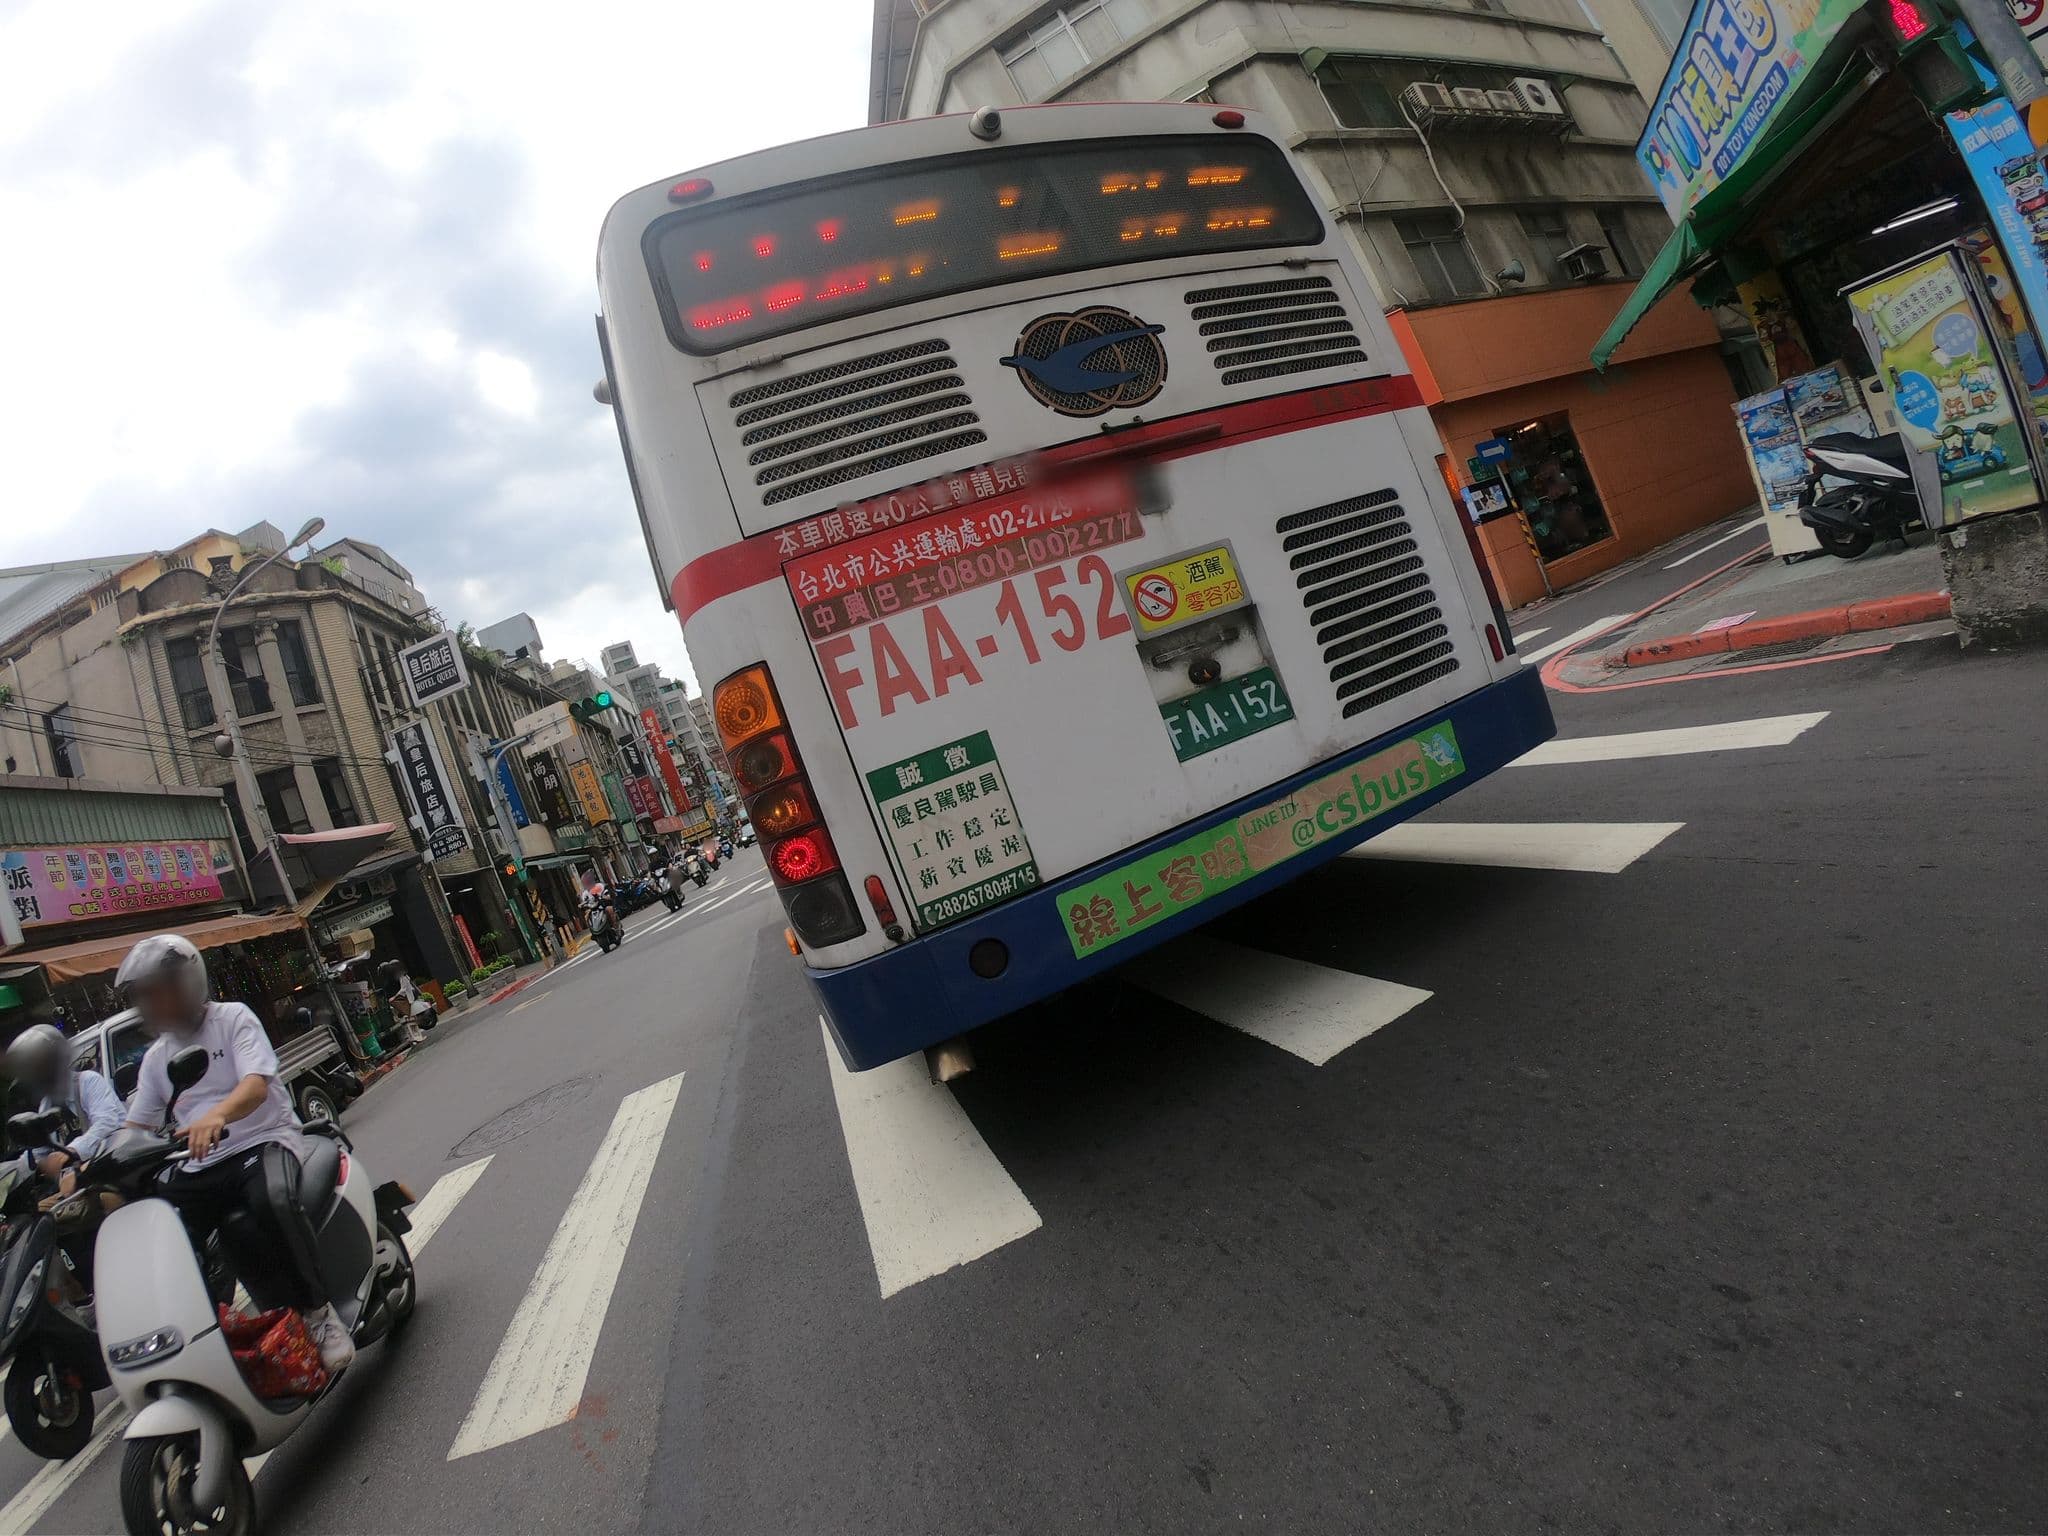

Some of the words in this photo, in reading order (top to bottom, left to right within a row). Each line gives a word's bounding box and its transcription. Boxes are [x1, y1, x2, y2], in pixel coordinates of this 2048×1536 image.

[1716, 154, 1732, 174] 101
[1726, 128, 1745, 156] TOY
[1743, 69, 1784, 137] KINGDOM
[1184, 555, 1225, 585] 酒駕
[1184, 579, 1244, 612] 零容忍
[408, 644, 452, 680] 皇后旅店
[815, 554, 1131, 730] FAA-152
[415, 676, 437, 693] HOTEL
[436, 669, 458, 686] QUEEN
[409, 746, 440, 810] 皇后旅店
[895, 745, 971, 790] 誠徵
[891, 771, 1001, 830] 優良駕駛員
[1242, 808, 1279, 837] LINE
[1291, 758, 1425, 848] @csbus
[906, 807, 1011, 862] 工作穩定
[44, 854, 65, 883] 年節
[65, 853, 87, 882] 聖誕
[87, 853, 106, 881] 萬聖
[160, 849, 176, 874] 生日
[919, 834, 1023, 890] 薪資優渥
[5, 866, 42, 921] 派對
[934, 865, 1036, 921] 28826780#715
